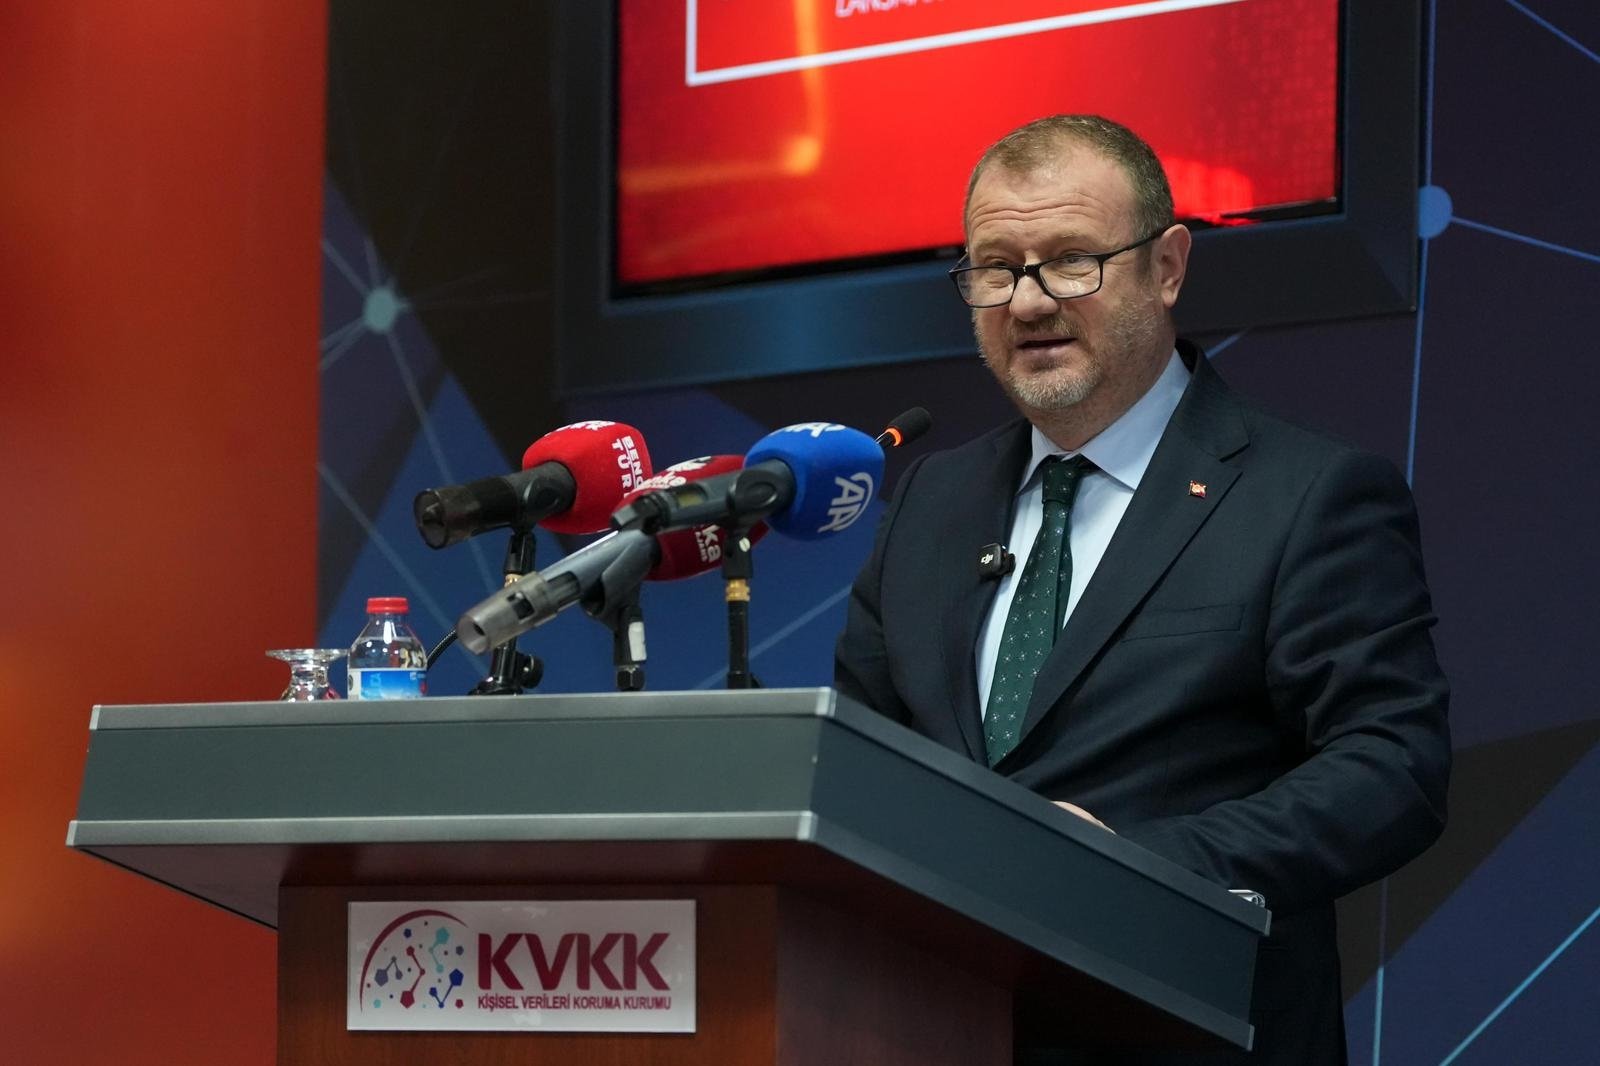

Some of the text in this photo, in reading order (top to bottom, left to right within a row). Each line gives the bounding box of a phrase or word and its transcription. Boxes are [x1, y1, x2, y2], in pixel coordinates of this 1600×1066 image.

[611, 438, 634, 499] TÜR
[621, 435, 644, 489] BENG
[818, 472, 872, 533] AA
[478, 932, 671, 991] KVKK
[478, 993, 672, 1012] KİŞİSEL VERİLERİ KORUMA KURUMU
